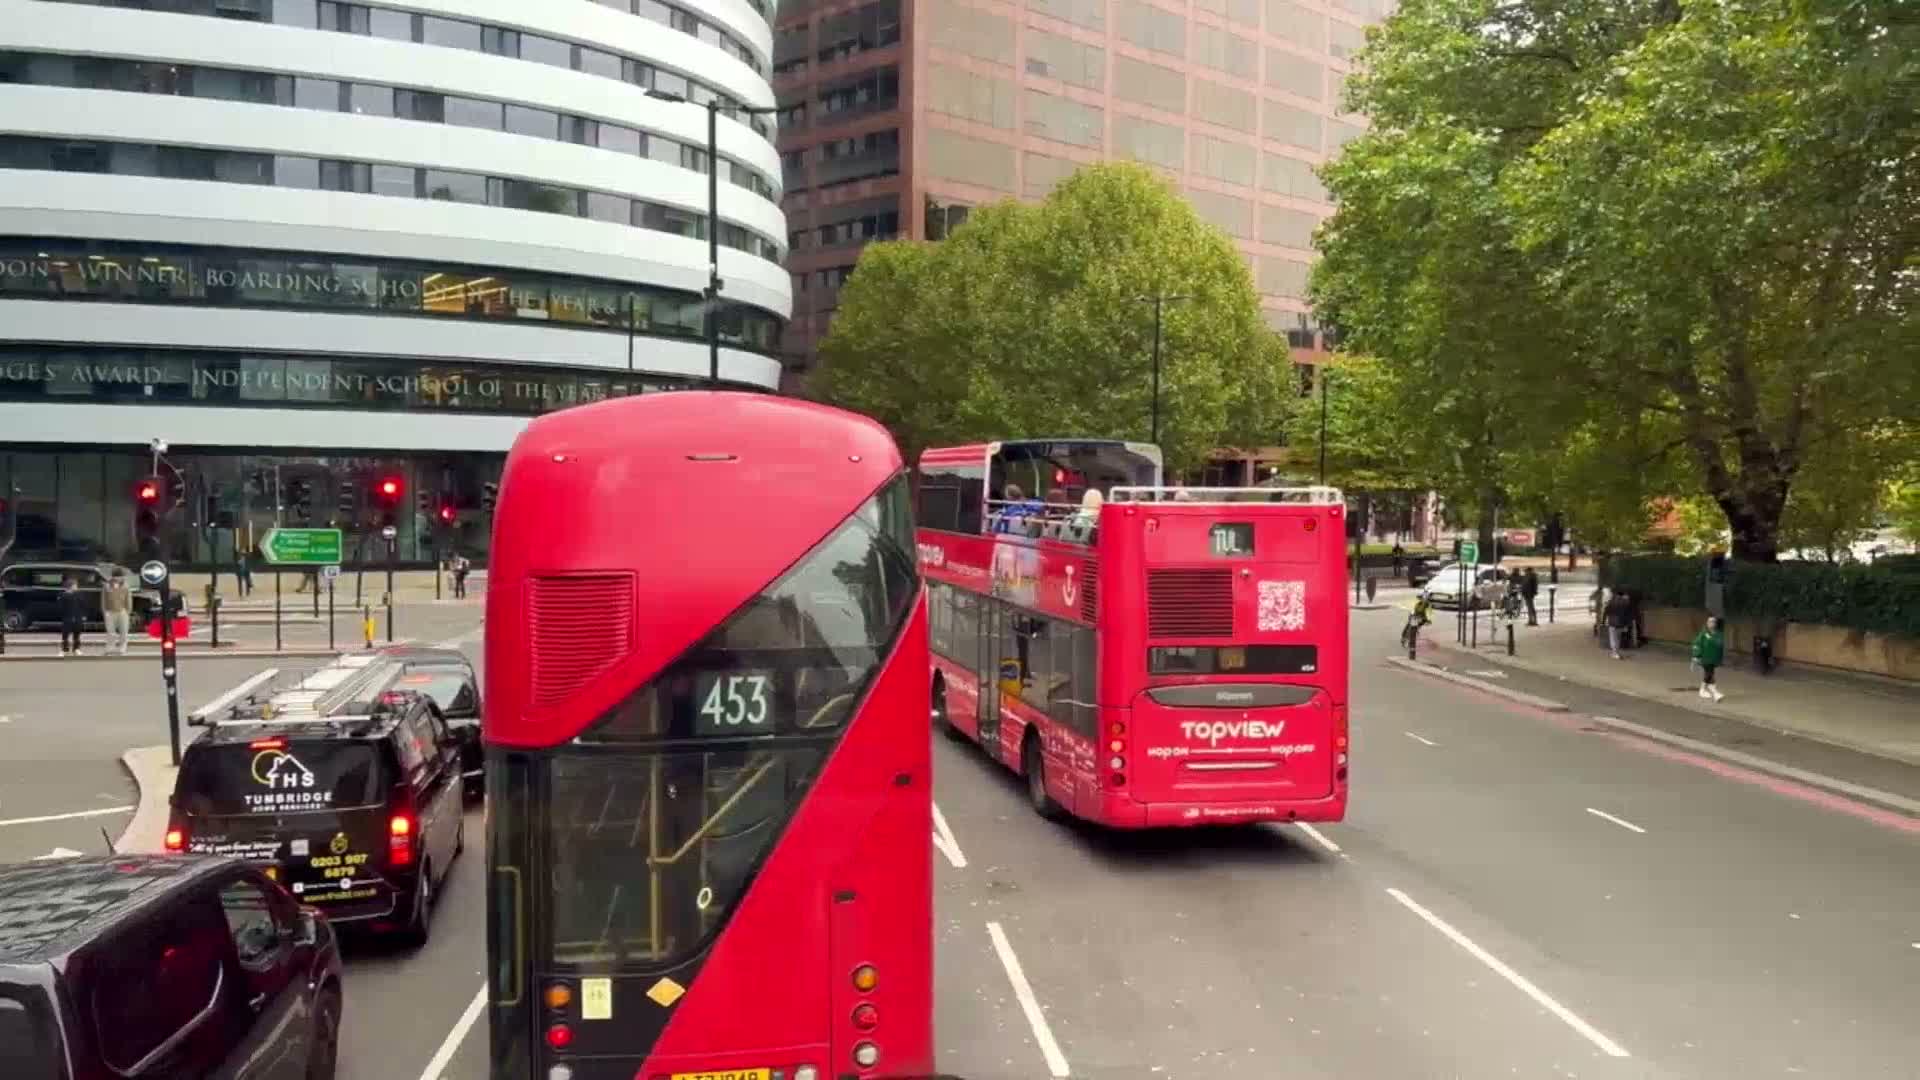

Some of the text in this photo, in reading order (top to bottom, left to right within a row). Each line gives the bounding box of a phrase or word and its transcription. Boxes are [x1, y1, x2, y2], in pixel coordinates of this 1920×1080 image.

[0, 259, 49, 277] ON
[206, 268, 342, 292] BOARDING
[71, 365, 161, 383] AWARD
[193, 368, 367, 391] INDEPENDENT
[376, 375, 473, 396] SCHOOL
[515, 383, 550, 400] THE
[701, 676, 767, 725] 453
[265, 771, 315, 789] THS
[244, 791, 333, 804] TUMBRIDGE
